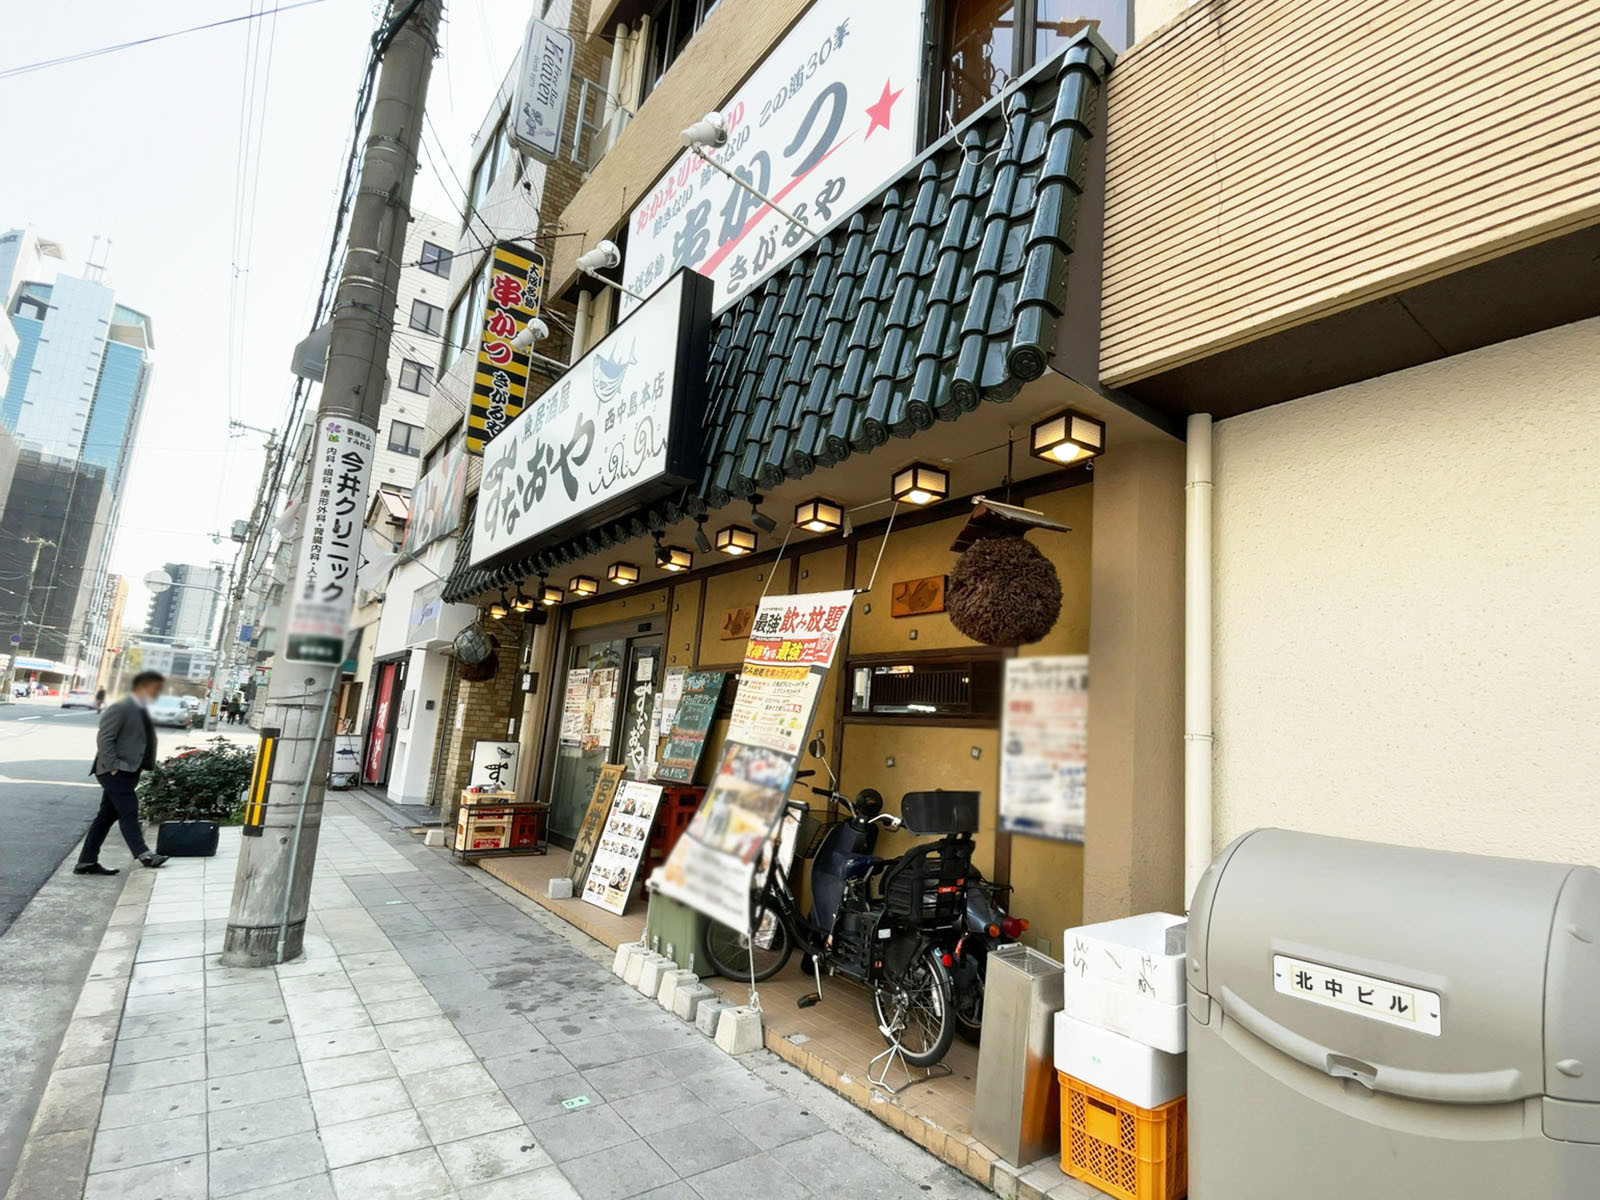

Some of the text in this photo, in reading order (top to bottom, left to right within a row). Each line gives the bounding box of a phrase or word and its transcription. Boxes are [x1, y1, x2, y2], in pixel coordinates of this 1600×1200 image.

[537, 35, 564, 106] Heaven
[636, 101, 744, 235] おかえりない
[670, 81, 848, 276] 串かつ
[726, 176, 846, 294] きがるや
[485, 275, 522, 364] 串かつ
[525, 264, 539, 309] 大阪名物
[347, 427, 372, 443] 医療法人
[486, 372, 510, 437] きがるや
[520, 379, 571, 443] 魚居酒屋
[604, 371, 666, 434] 西中島本店
[347, 436, 371, 451] すみれ会
[322, 450, 364, 602] 今井クリニック
[573, 770, 615, 882] 営業中
[1295, 970, 1409, 1015] 北中ビル
